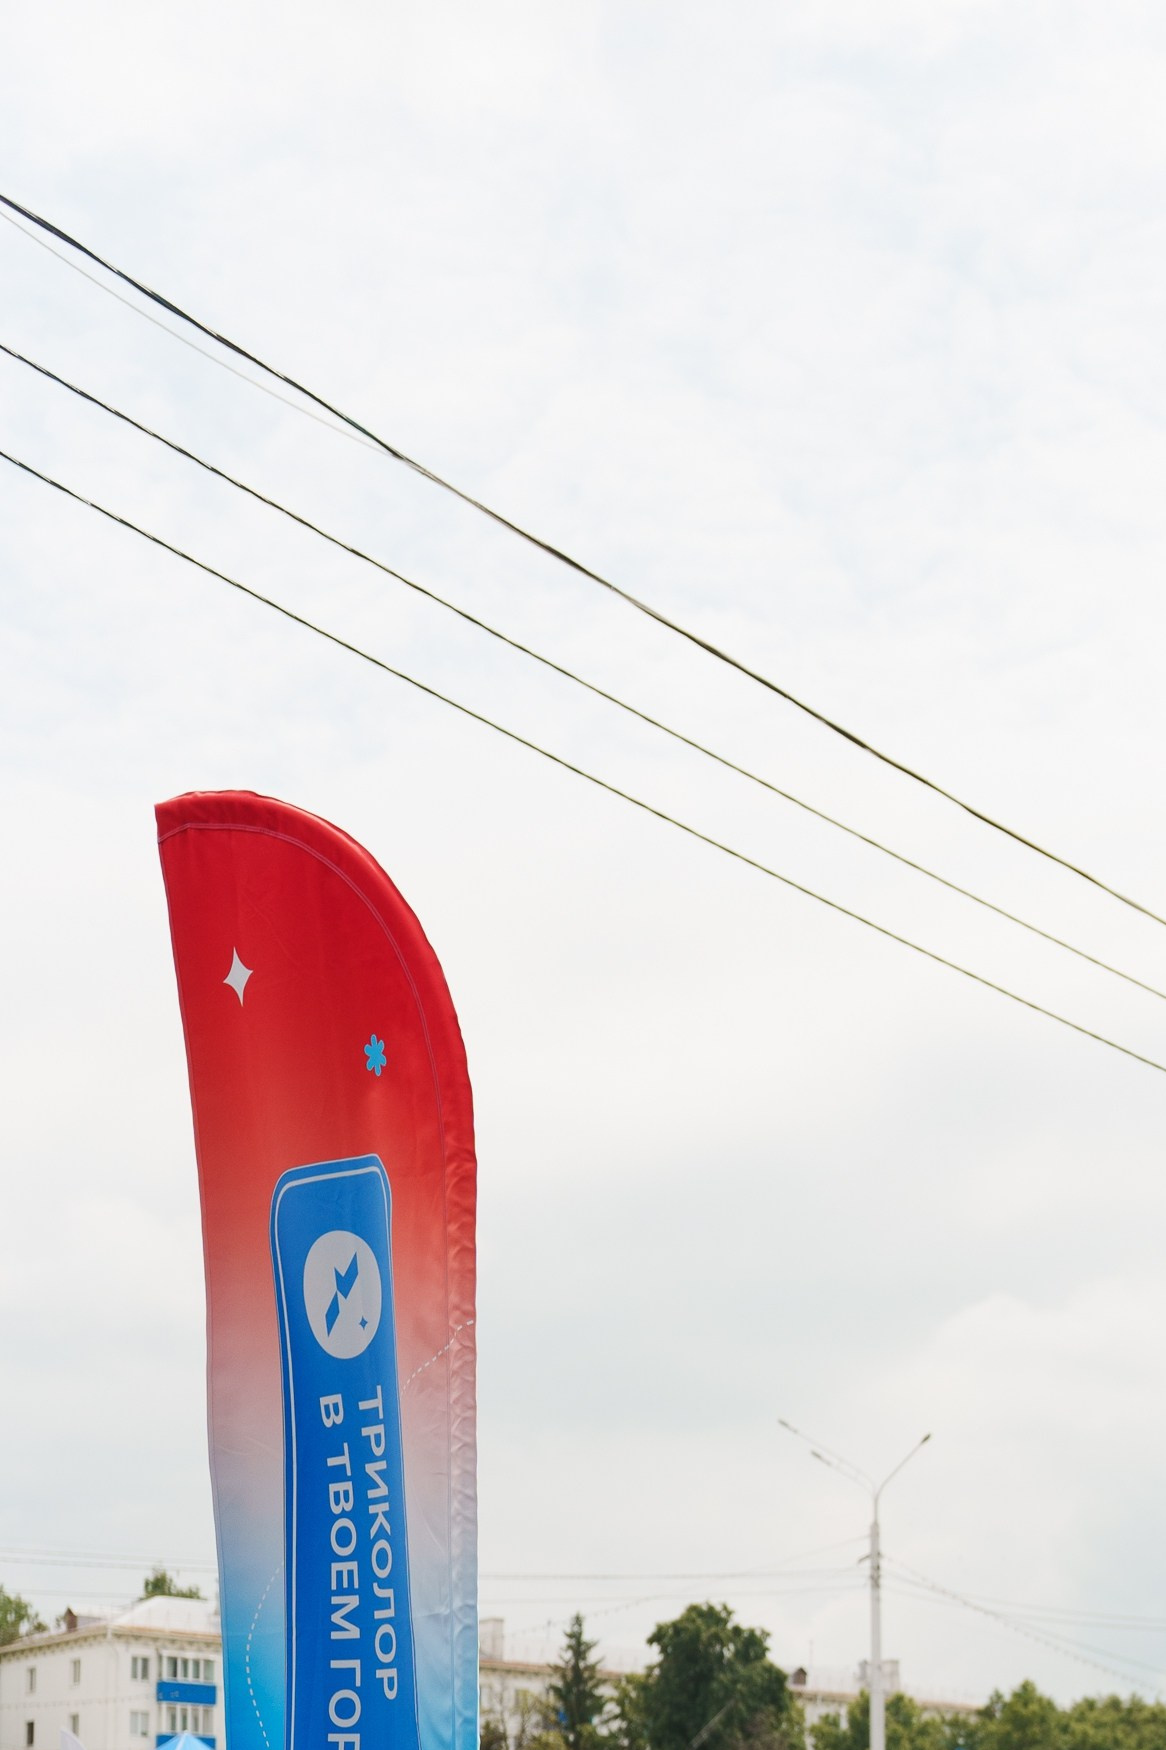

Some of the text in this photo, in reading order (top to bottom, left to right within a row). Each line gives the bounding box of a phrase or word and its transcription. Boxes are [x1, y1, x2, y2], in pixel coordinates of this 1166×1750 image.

[319, 1393, 344, 1428] В
[327, 1442, 361, 1640] ТВОЕМ
[358, 1385, 398, 1700] ТРИКОЛОР
